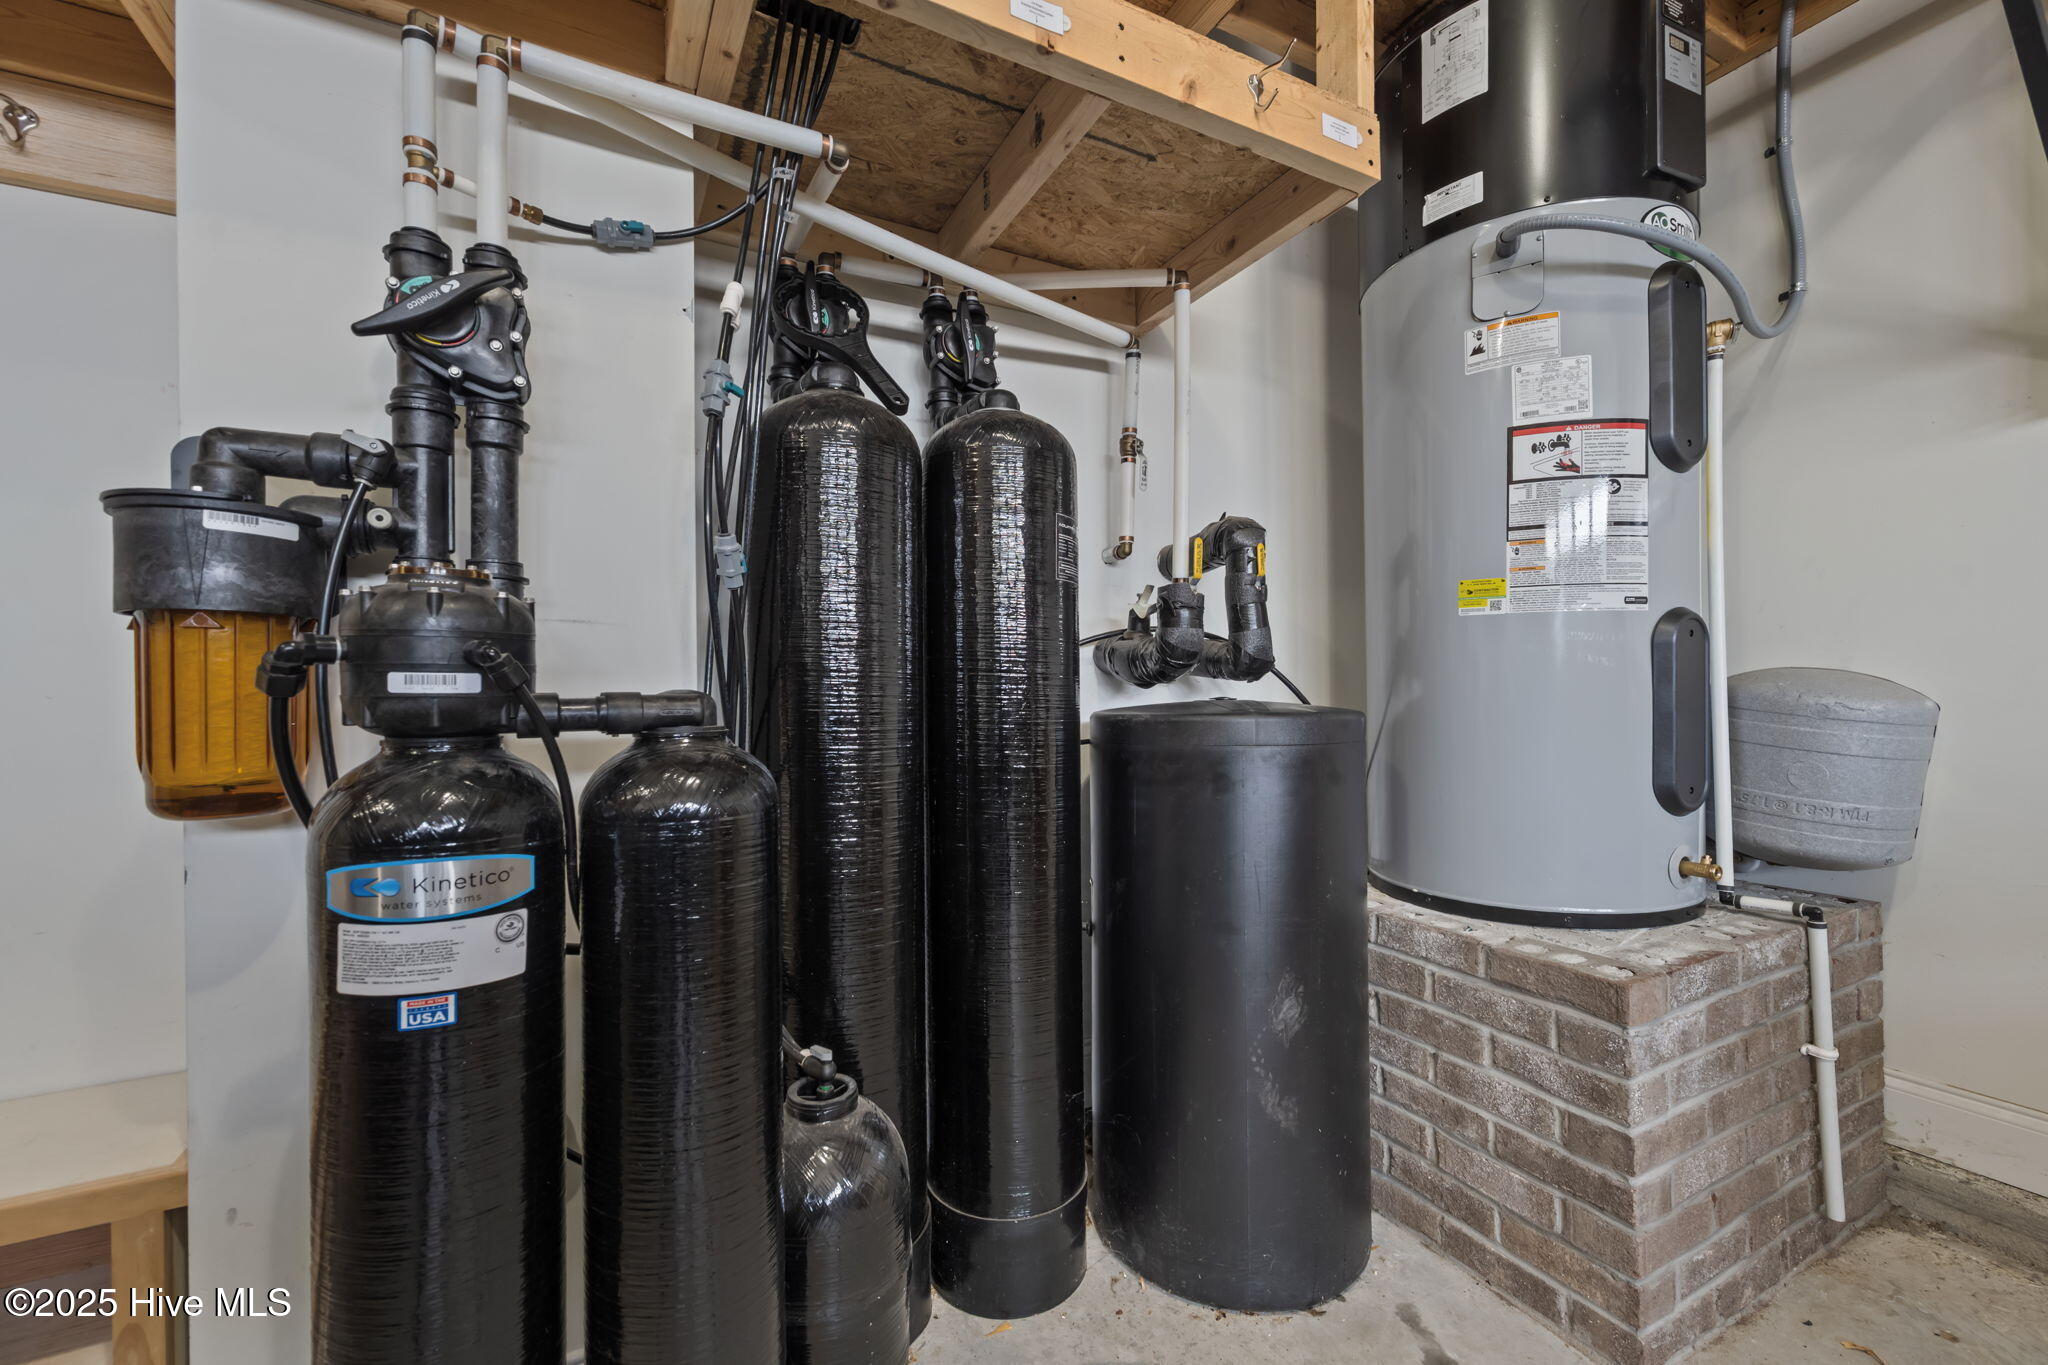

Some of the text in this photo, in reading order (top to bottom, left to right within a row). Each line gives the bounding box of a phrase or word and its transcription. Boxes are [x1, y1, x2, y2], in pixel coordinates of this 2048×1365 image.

[407, 289, 441, 309] Kinetico
[413, 870, 511, 894] Kinetico
[382, 893, 482, 911] water systems
[409, 1010, 446, 1025] USA
